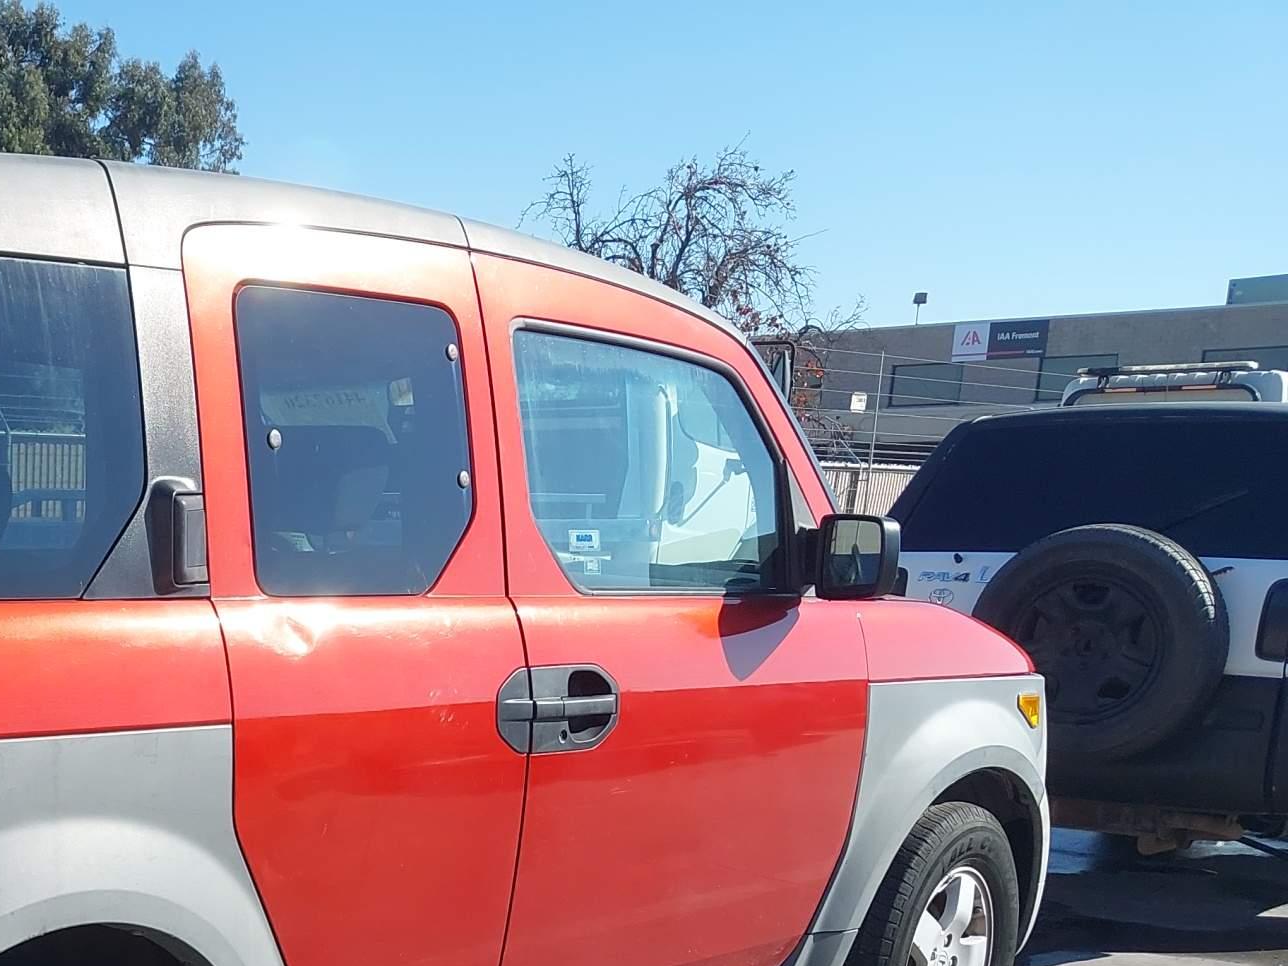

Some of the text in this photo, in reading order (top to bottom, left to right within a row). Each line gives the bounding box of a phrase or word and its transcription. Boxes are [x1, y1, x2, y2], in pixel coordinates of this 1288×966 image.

[997, 331, 1040, 341] IAA Fremont
[917, 571, 971, 582] RAV4
